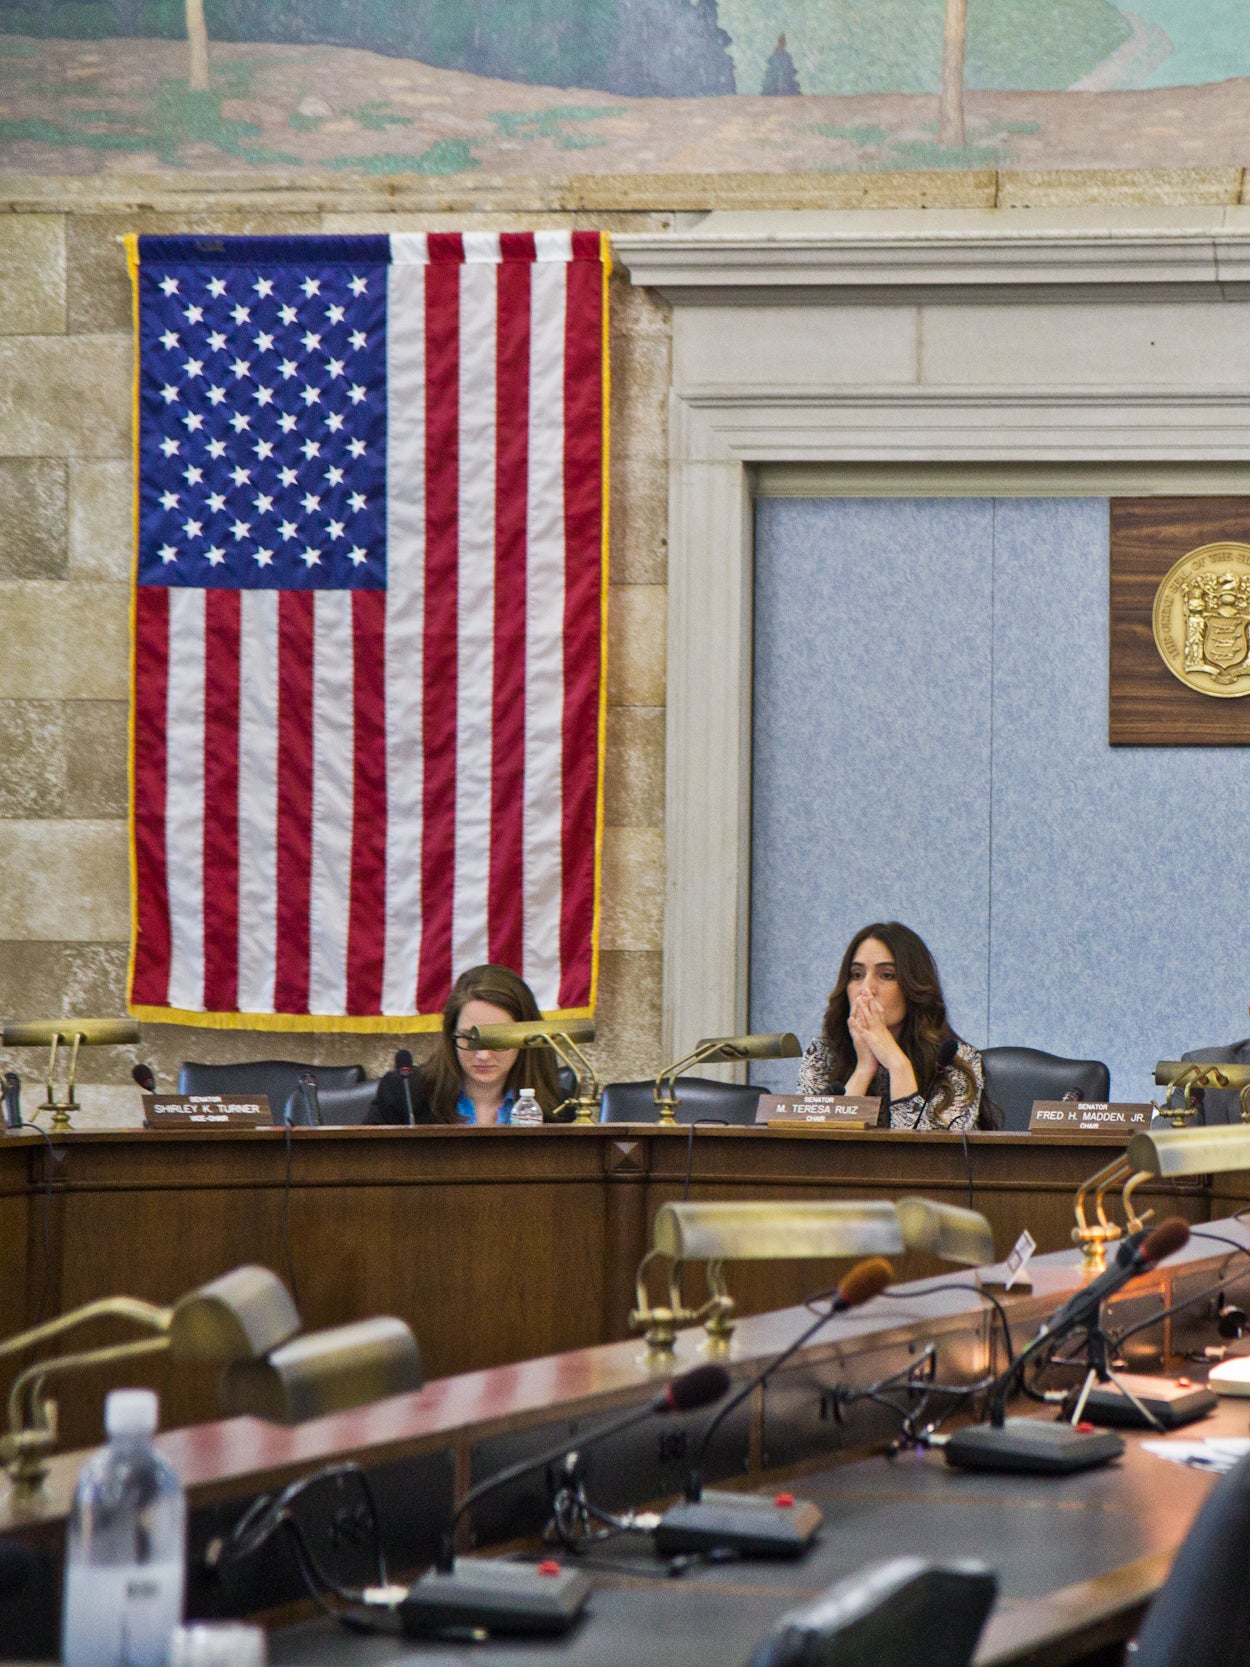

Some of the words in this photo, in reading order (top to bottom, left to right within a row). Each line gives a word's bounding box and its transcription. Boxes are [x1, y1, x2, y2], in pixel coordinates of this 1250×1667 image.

[803, 1096, 835, 1104] SENATOR
[153, 1104, 198, 1114] SHIRLEY
[216, 1104, 260, 1114] TURNER
[776, 1104, 787, 1113] M.
[792, 1104, 831, 1114] TERESA
[835, 1105, 859, 1115] RUIZ
[1036, 1111, 1064, 1120] FRED
[1068, 1112, 1078, 1121] H.
[1130, 1113, 1146, 1123] JR.
